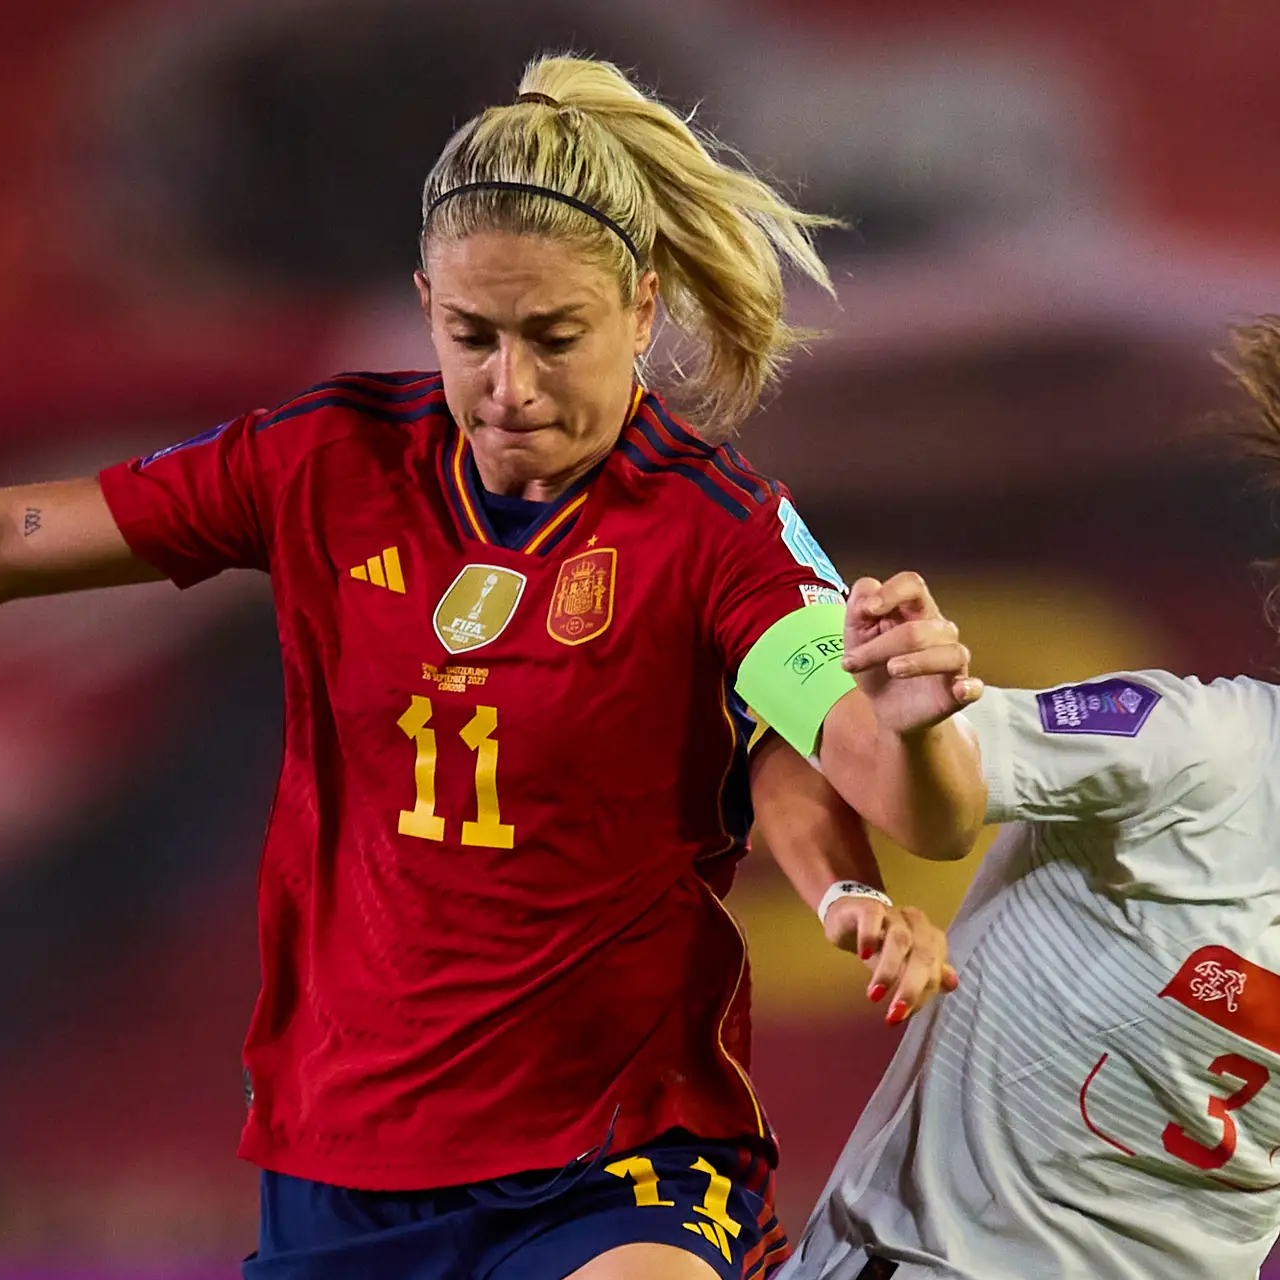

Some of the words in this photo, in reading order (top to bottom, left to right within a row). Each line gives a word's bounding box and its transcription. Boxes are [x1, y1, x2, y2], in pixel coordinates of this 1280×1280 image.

[451, 617, 481, 634] FIFA
[396, 695, 514, 849] 11
[1161, 1053, 1269, 1170] 3
